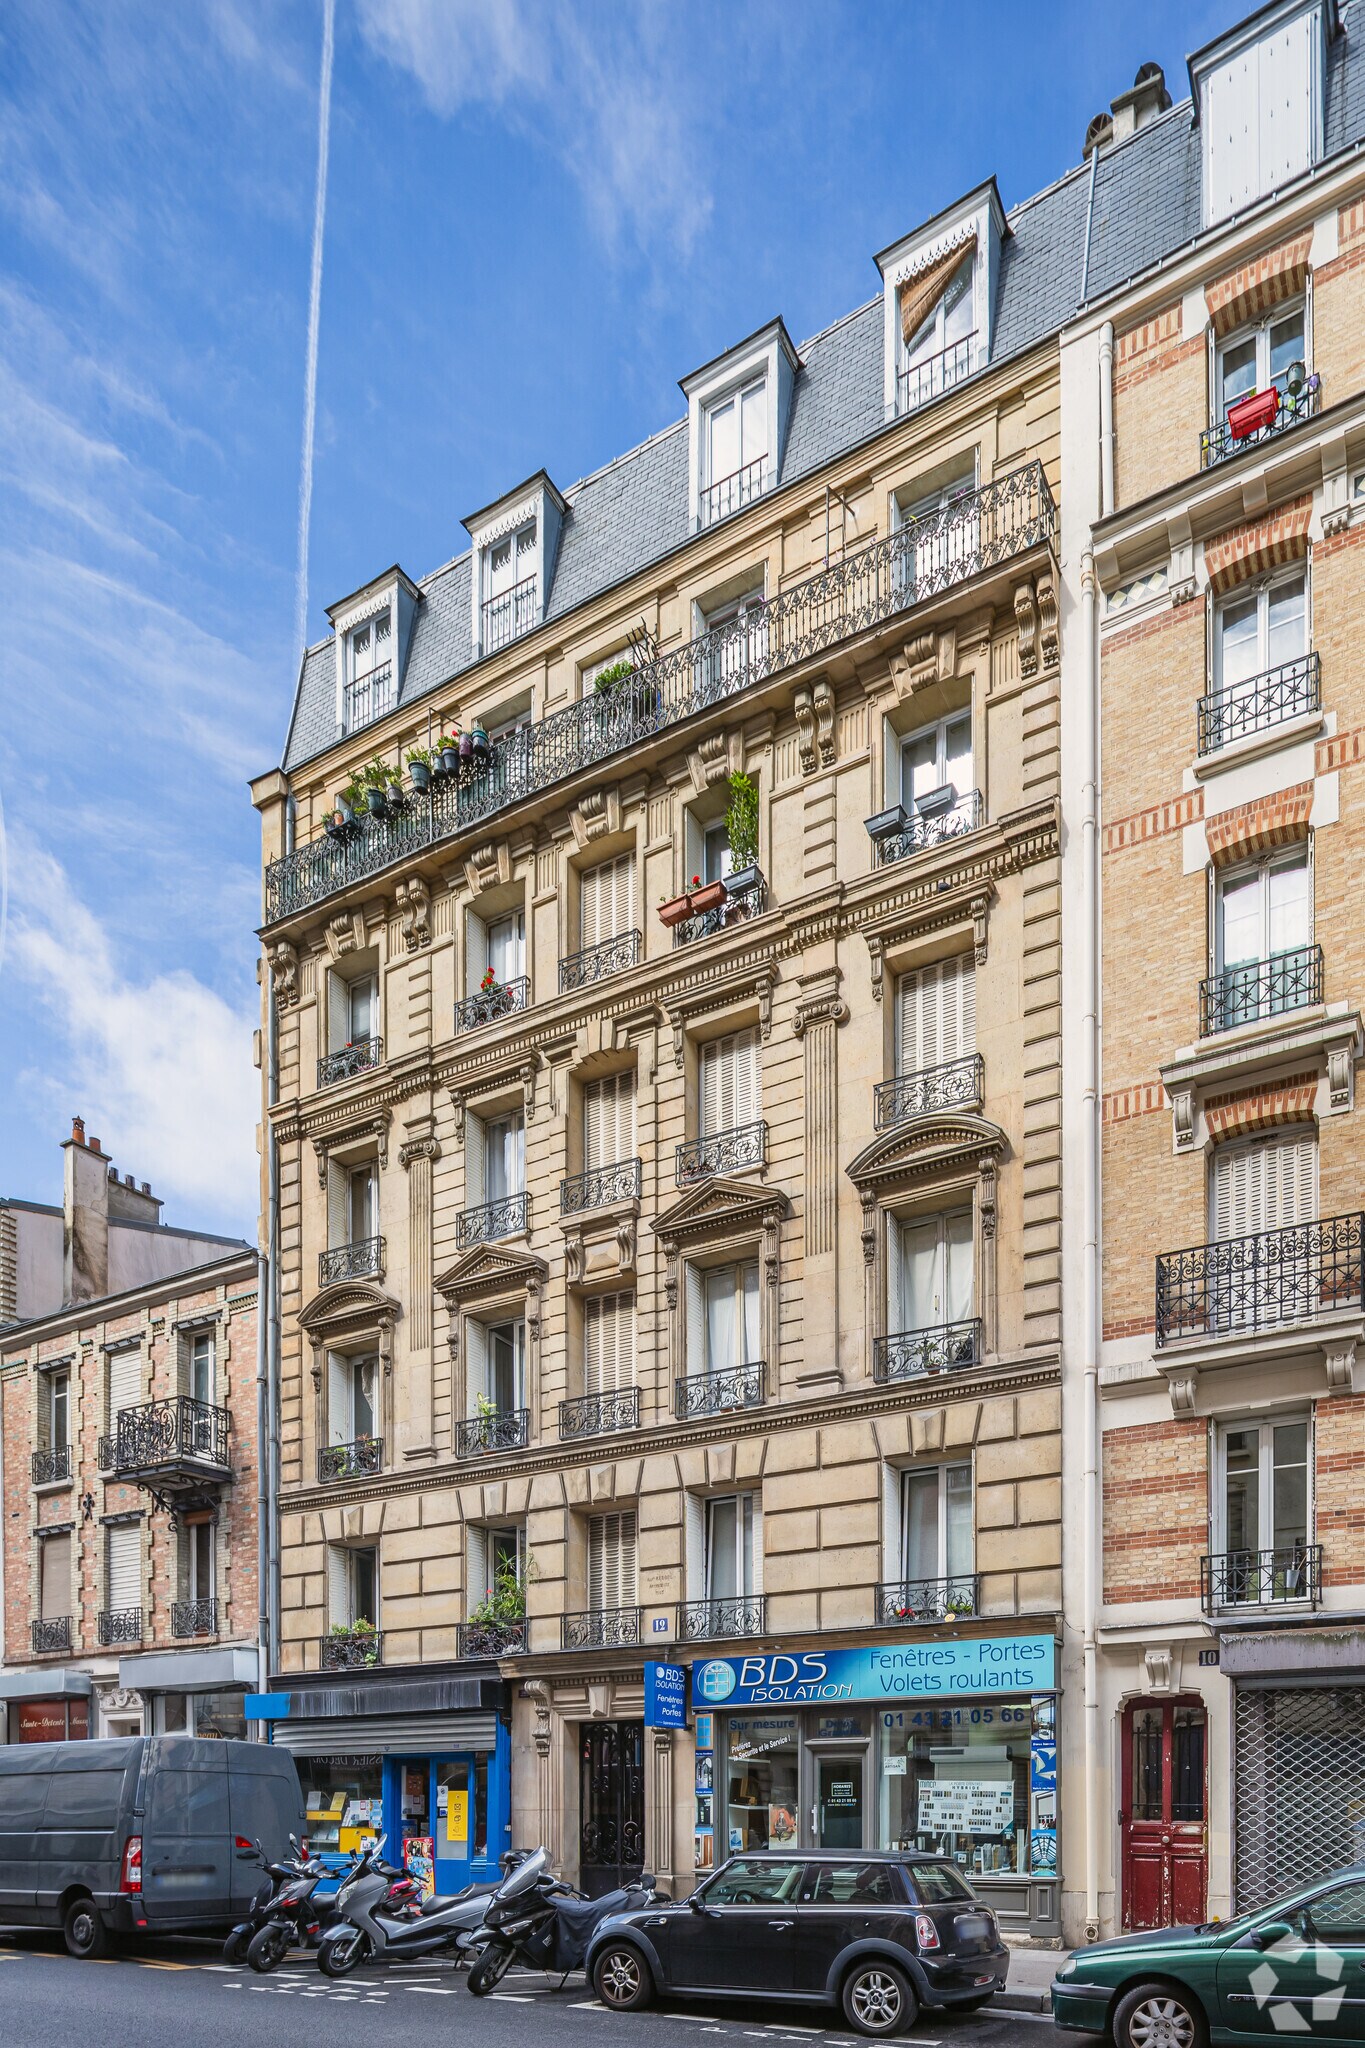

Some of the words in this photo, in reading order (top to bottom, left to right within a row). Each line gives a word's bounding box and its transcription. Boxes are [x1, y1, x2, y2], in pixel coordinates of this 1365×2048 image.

[655, 1619, 667, 1632] 12
[870, 1649, 956, 1669] Fenêtres
[979, 1643, 1046, 1663] Portes
[1201, 1651, 1217, 1665] 10
[665, 1668, 686, 1683] BDS
[739, 1653, 827, 1687] BDS
[655, 1680, 685, 1691] ISOLATION
[880, 1673, 942, 1692] Volets
[950, 1668, 1034, 1689] roulants
[750, 1683, 853, 1701] ISOLATION
[662, 1707, 682, 1717] Portes
[883, 1713, 903, 1727] 01
[912, 1711, 934, 1726] 43
[970, 1709, 993, 1724] 05
[1001, 1707, 1025, 1722] 66
[730, 1720, 749, 1731] Sur
[752, 1719, 796, 1730] mesure
[769, 1736, 788, 1748] Service
